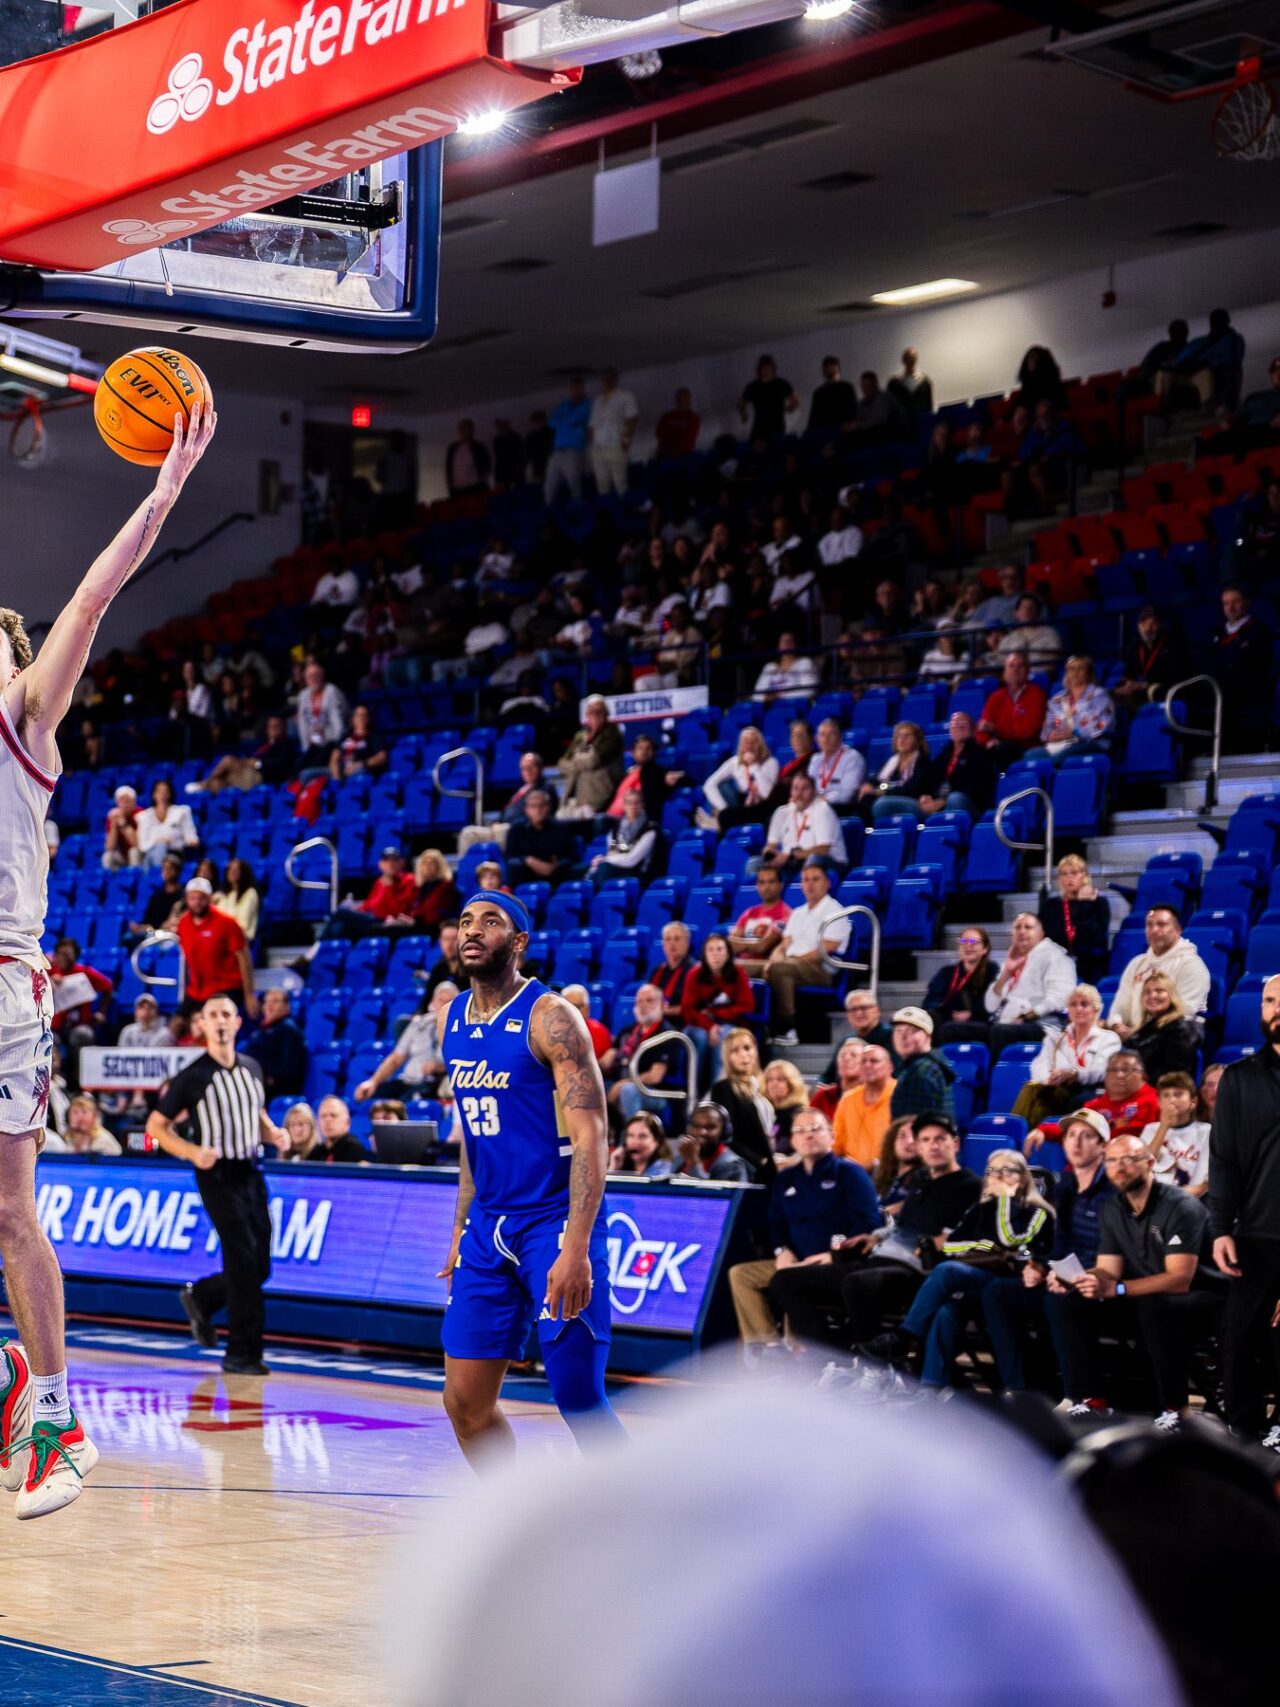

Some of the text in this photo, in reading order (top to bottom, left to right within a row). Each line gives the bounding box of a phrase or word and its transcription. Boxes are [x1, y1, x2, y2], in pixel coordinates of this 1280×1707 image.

[103, 1055, 169, 1079] SECTION
[448, 1059, 511, 1090] Tulsa
[461, 1095, 500, 1136] 23
[72, 1186, 203, 1250] HOME
